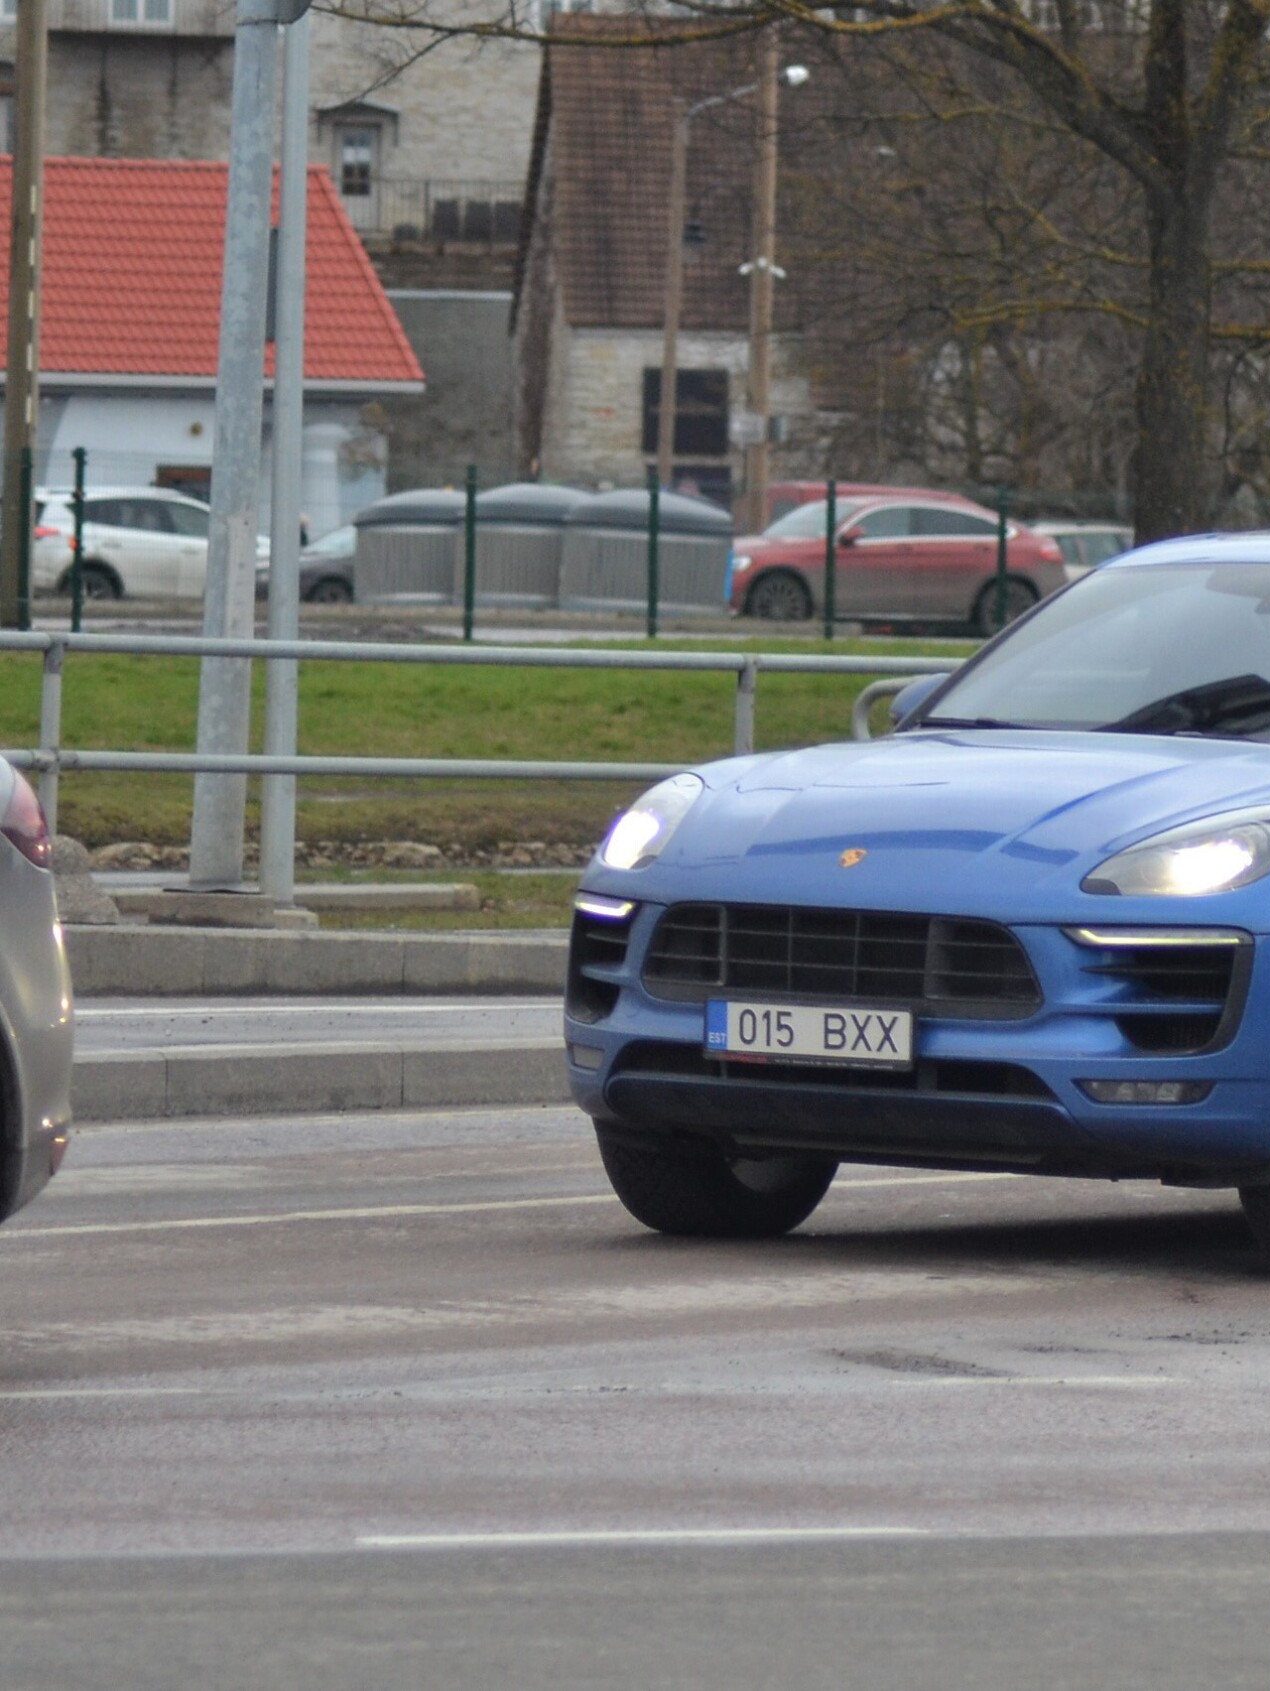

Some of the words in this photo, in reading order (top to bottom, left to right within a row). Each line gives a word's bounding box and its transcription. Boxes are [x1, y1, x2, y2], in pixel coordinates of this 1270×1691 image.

[708, 1032, 727, 1044] EST
[739, 1008, 794, 1048] 015
[824, 1012, 899, 1053] BXX
